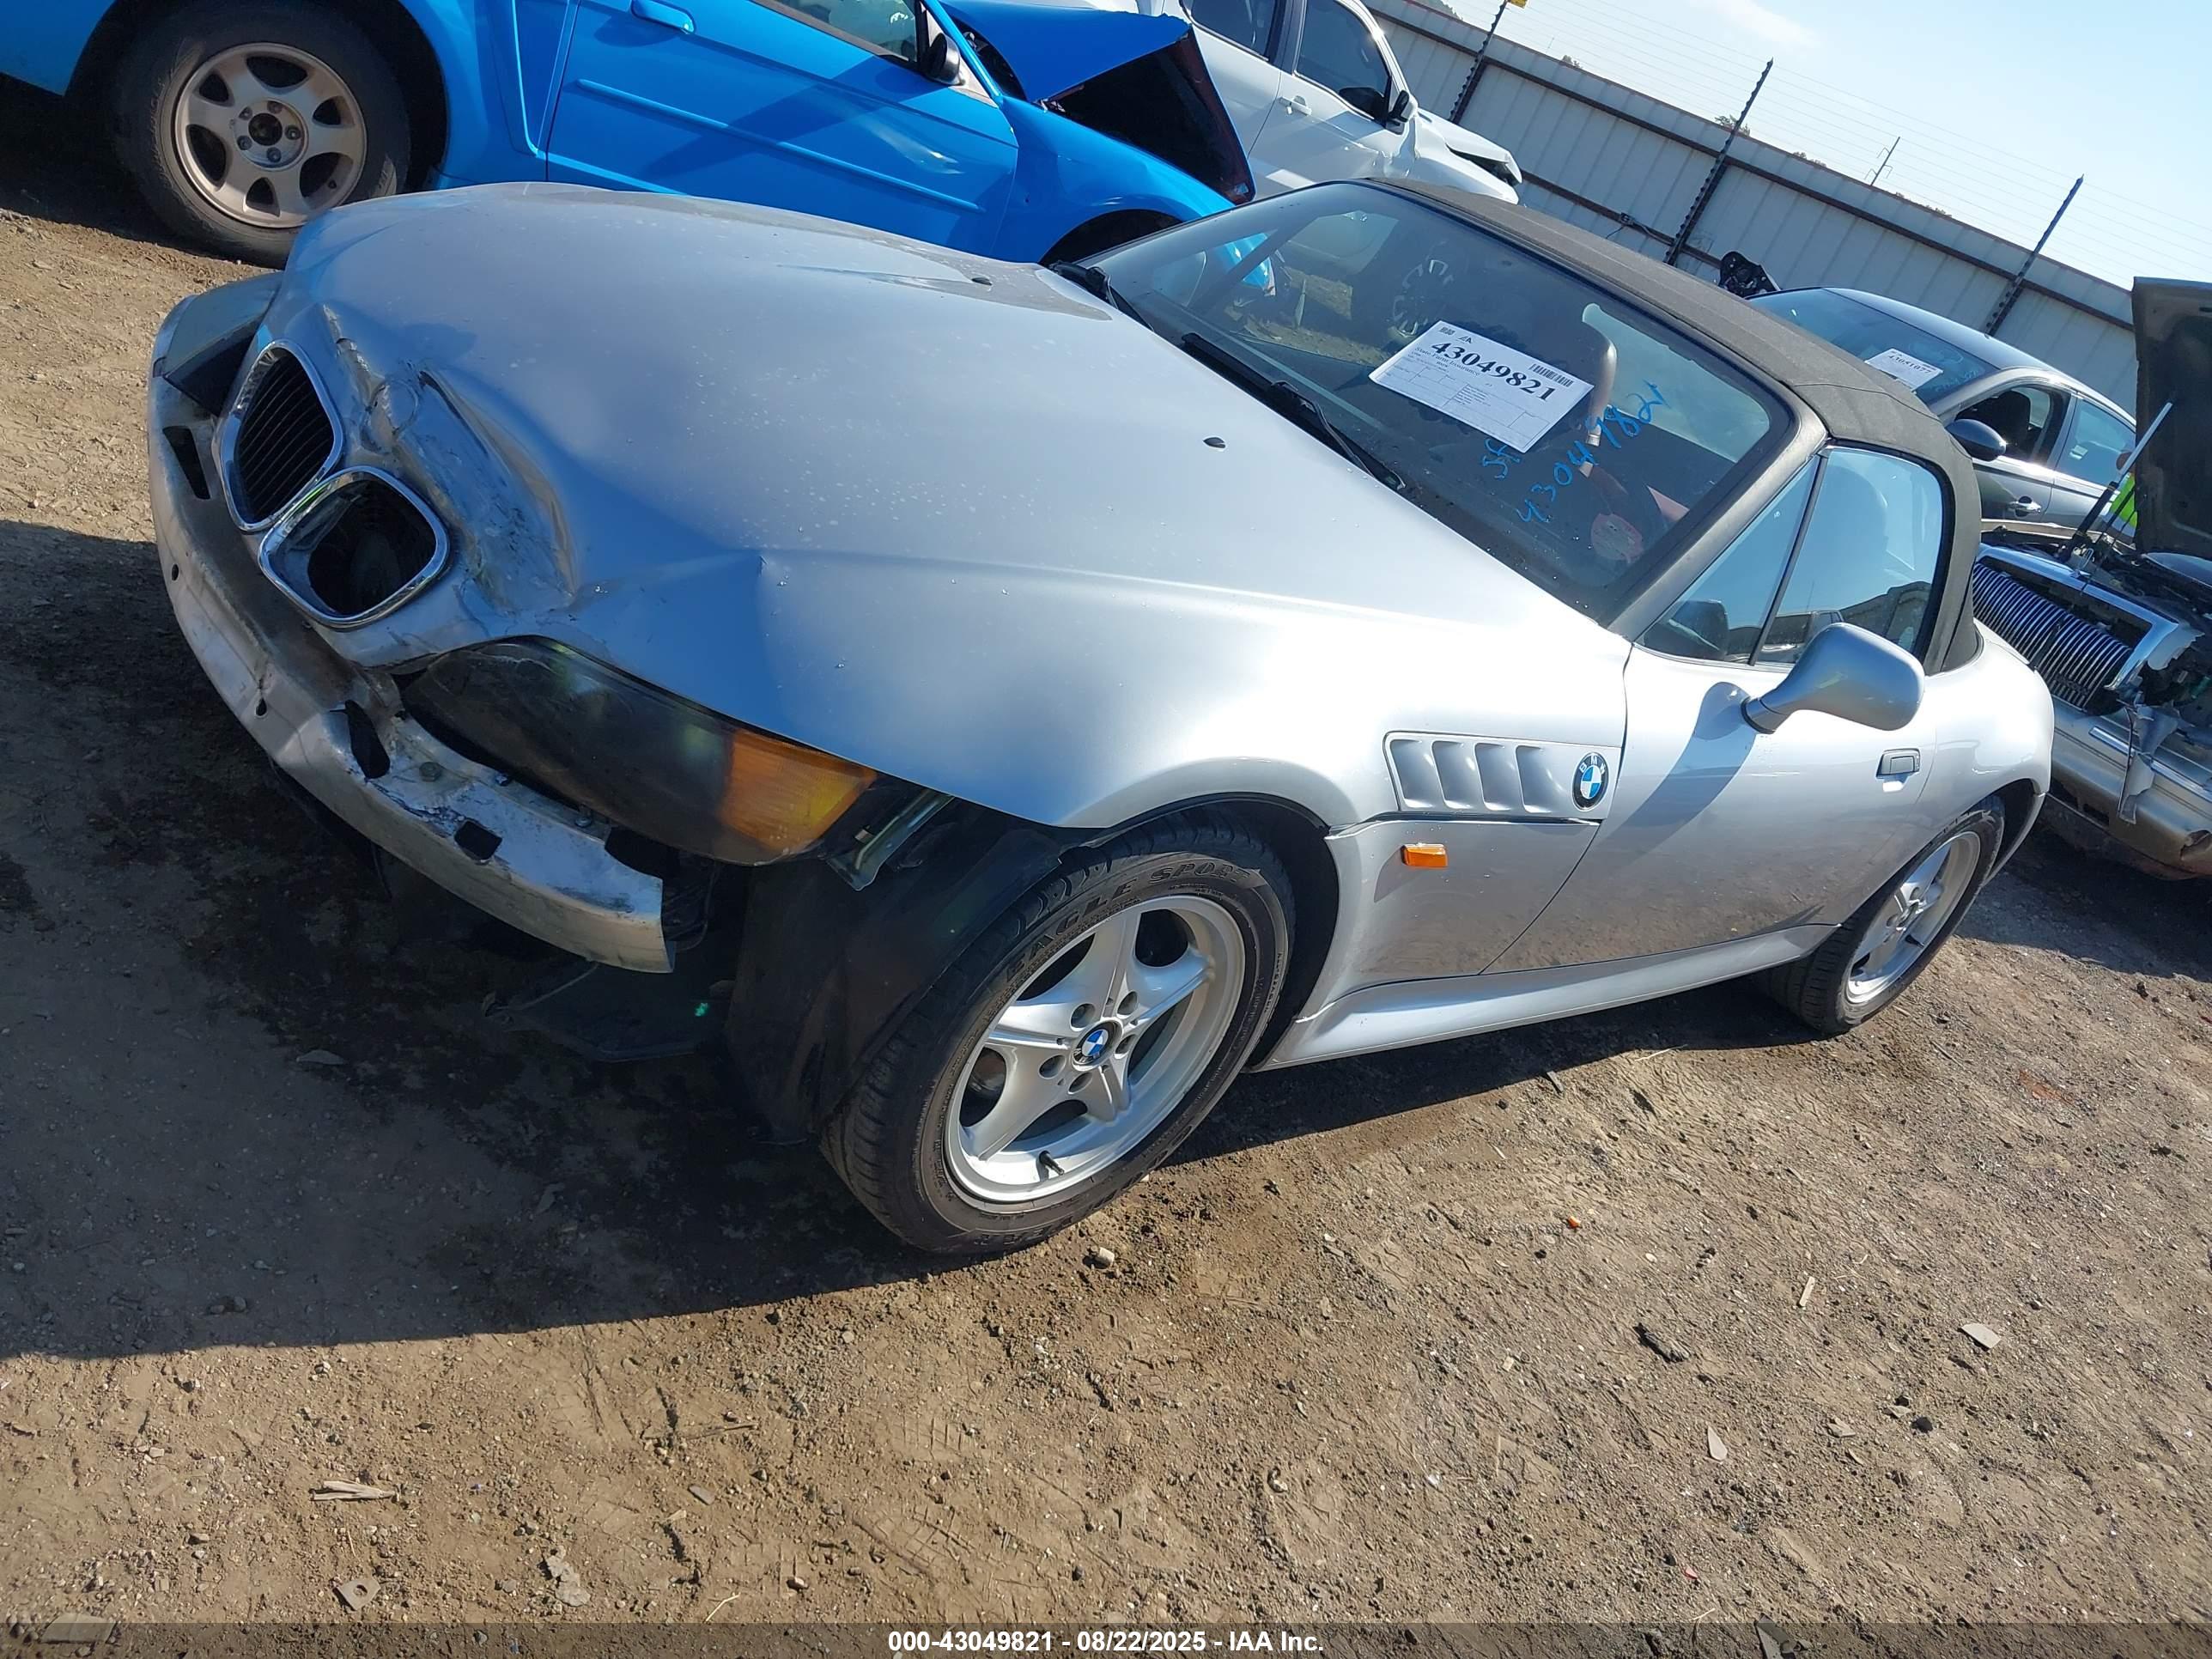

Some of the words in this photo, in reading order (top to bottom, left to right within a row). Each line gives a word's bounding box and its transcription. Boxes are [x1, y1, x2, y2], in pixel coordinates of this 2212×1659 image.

[1415, 346, 1431, 356] State
[1432, 352, 1449, 363] Farm
[1449, 360, 1481, 376] Insurance
[1431, 342, 1557, 401] 43049821
[1005, 878, 1138, 983] EAGLE
[1147, 860, 1251, 886] SPORT
